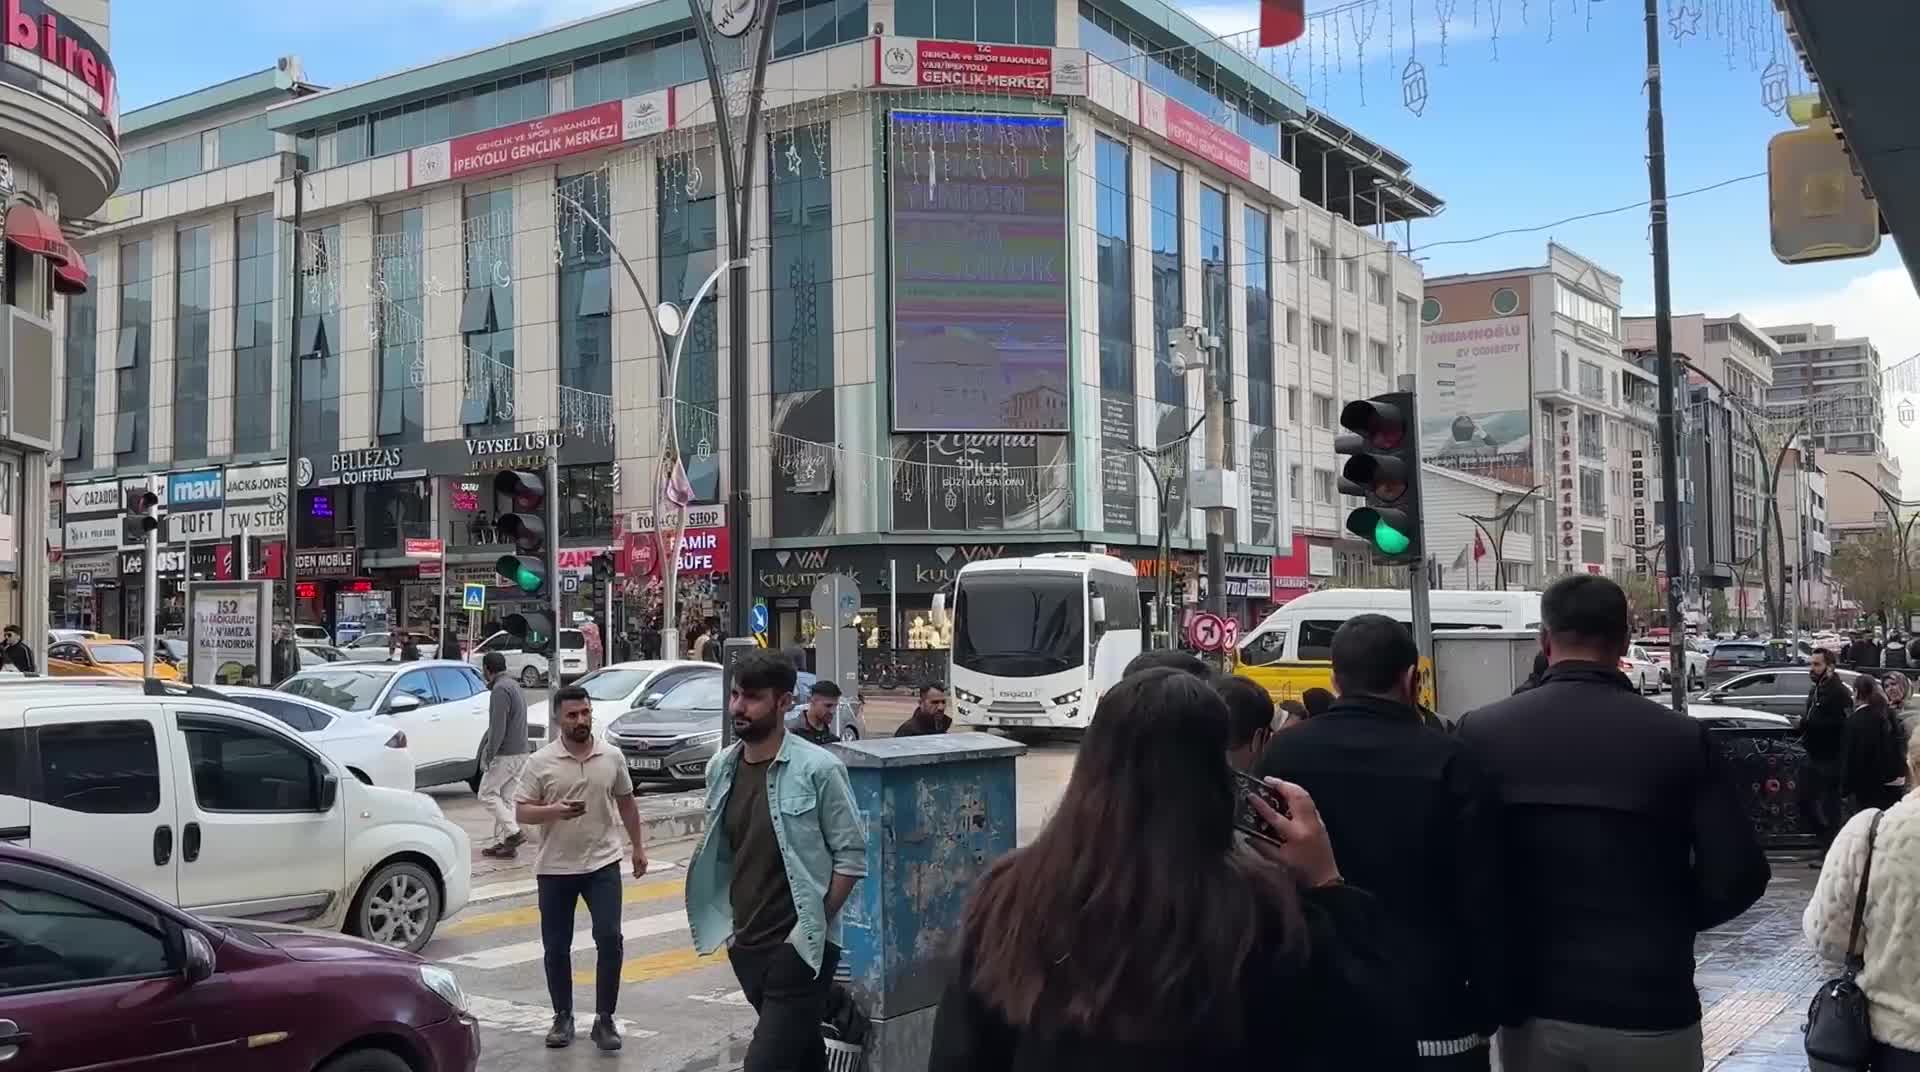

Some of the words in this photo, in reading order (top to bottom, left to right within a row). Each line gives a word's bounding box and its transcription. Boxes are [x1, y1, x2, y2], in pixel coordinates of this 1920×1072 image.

[9, 0, 117, 117] birey
[973, 53, 998, 62] SPOR
[922, 71, 985, 86] GENÇLİK
[987, 74, 1049, 90] MERKEZİ
[454, 148, 508, 172] İPEKYOLU
[511, 137, 561, 160] GENÇLİK
[564, 122, 618, 150] MERKEZİ
[465, 437, 522, 455] VEYSEL
[524, 432, 565, 450] USLU
[331, 447, 401, 472] BELLEZAS
[174, 471, 222, 502] mavi
[226, 477, 287, 492] JACK&JONES
[342, 468, 395, 485] COIFFEUR
[181, 511, 213, 534] LOFT
[689, 511, 719, 525] SHOP
[122, 554, 142, 574] Lee
[217, 600, 238, 614] 152
